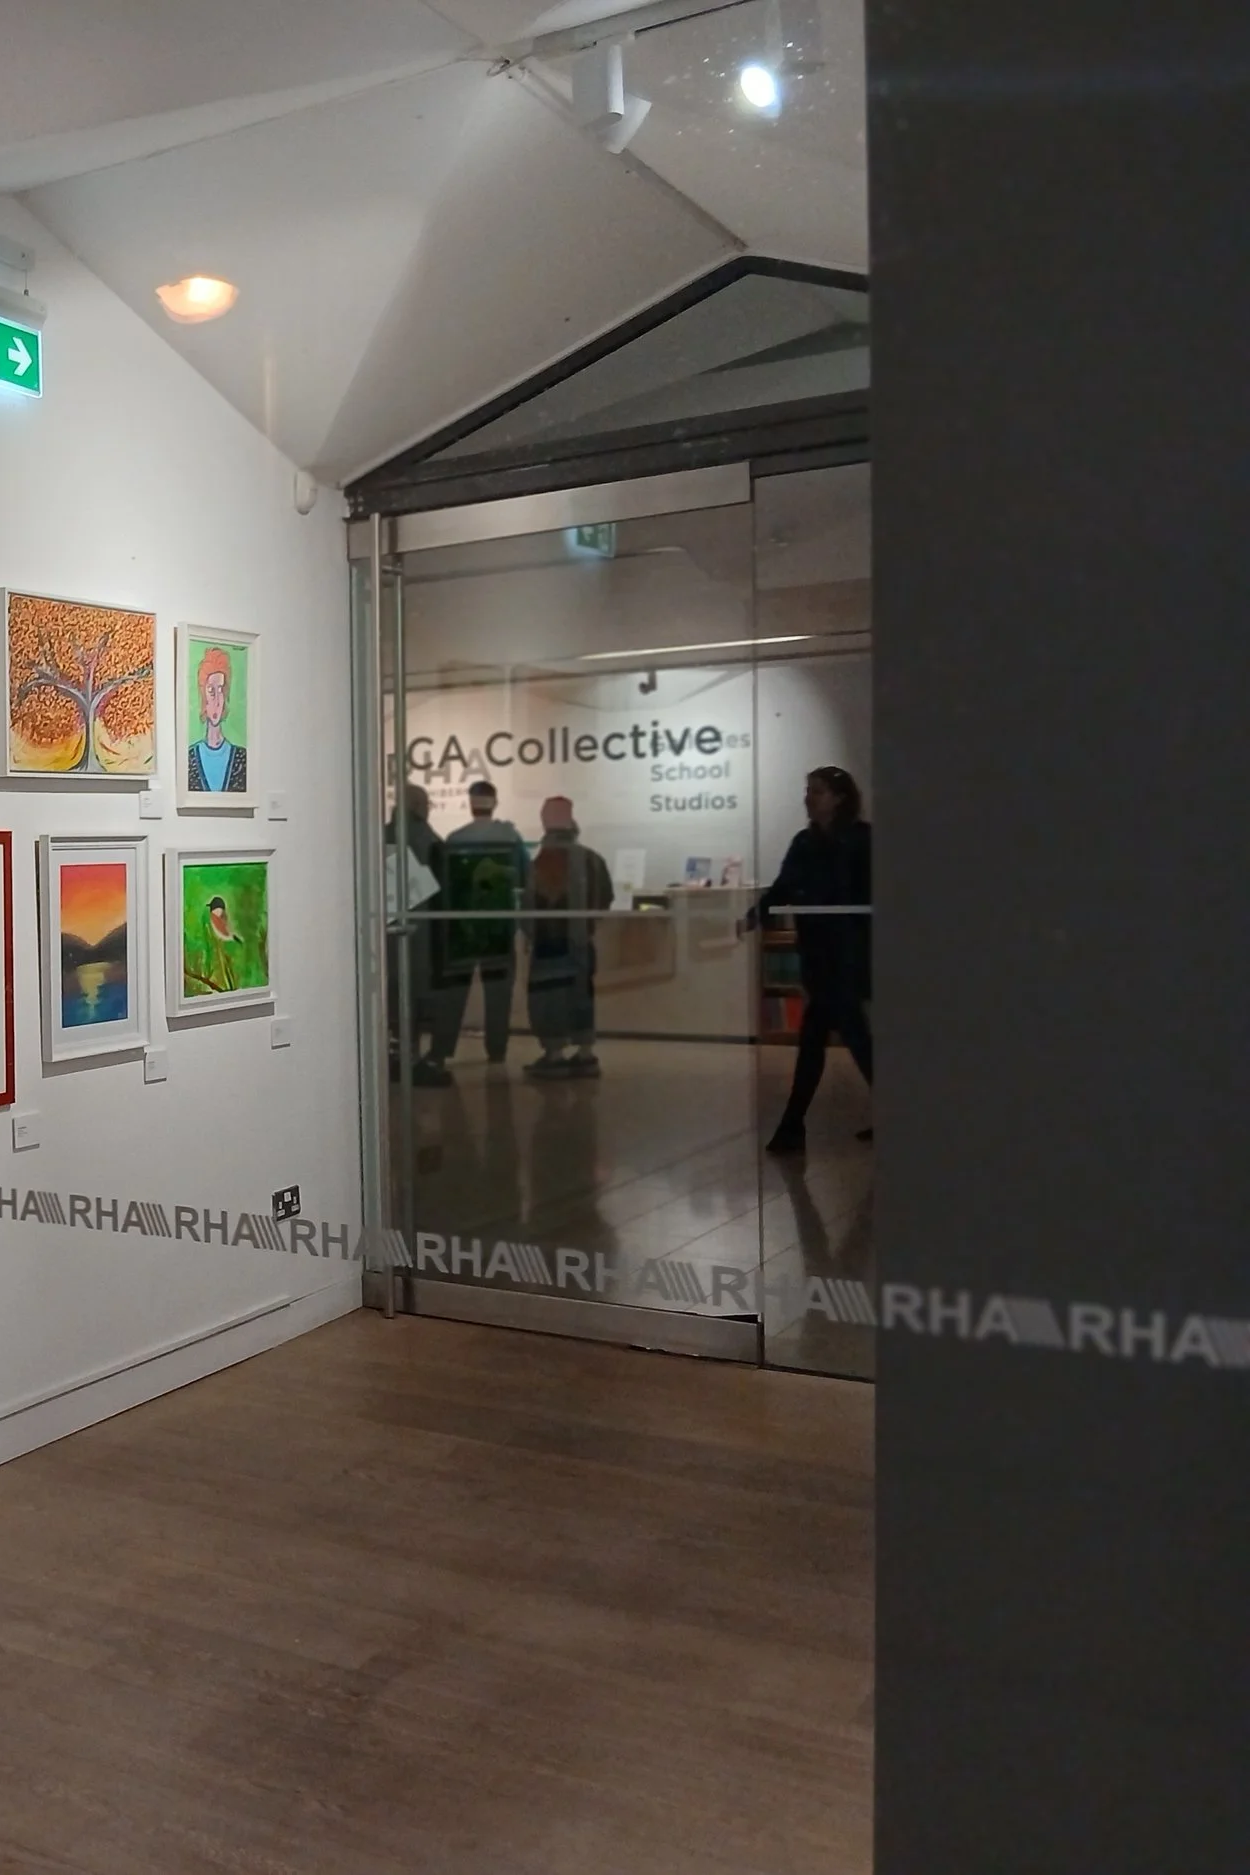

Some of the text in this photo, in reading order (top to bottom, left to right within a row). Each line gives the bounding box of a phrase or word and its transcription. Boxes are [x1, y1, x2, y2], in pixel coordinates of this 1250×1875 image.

[485, 720, 723, 768] Collective
[650, 760, 730, 782] School
[650, 791, 738, 812] Studios
[69, 1193, 149, 1236] RHA
[174, 1205, 261, 1250] RHA
[416, 1231, 521, 1282] RHA
[881, 1282, 1019, 1344] RHA
[1067, 1301, 1222, 1369] RHA
